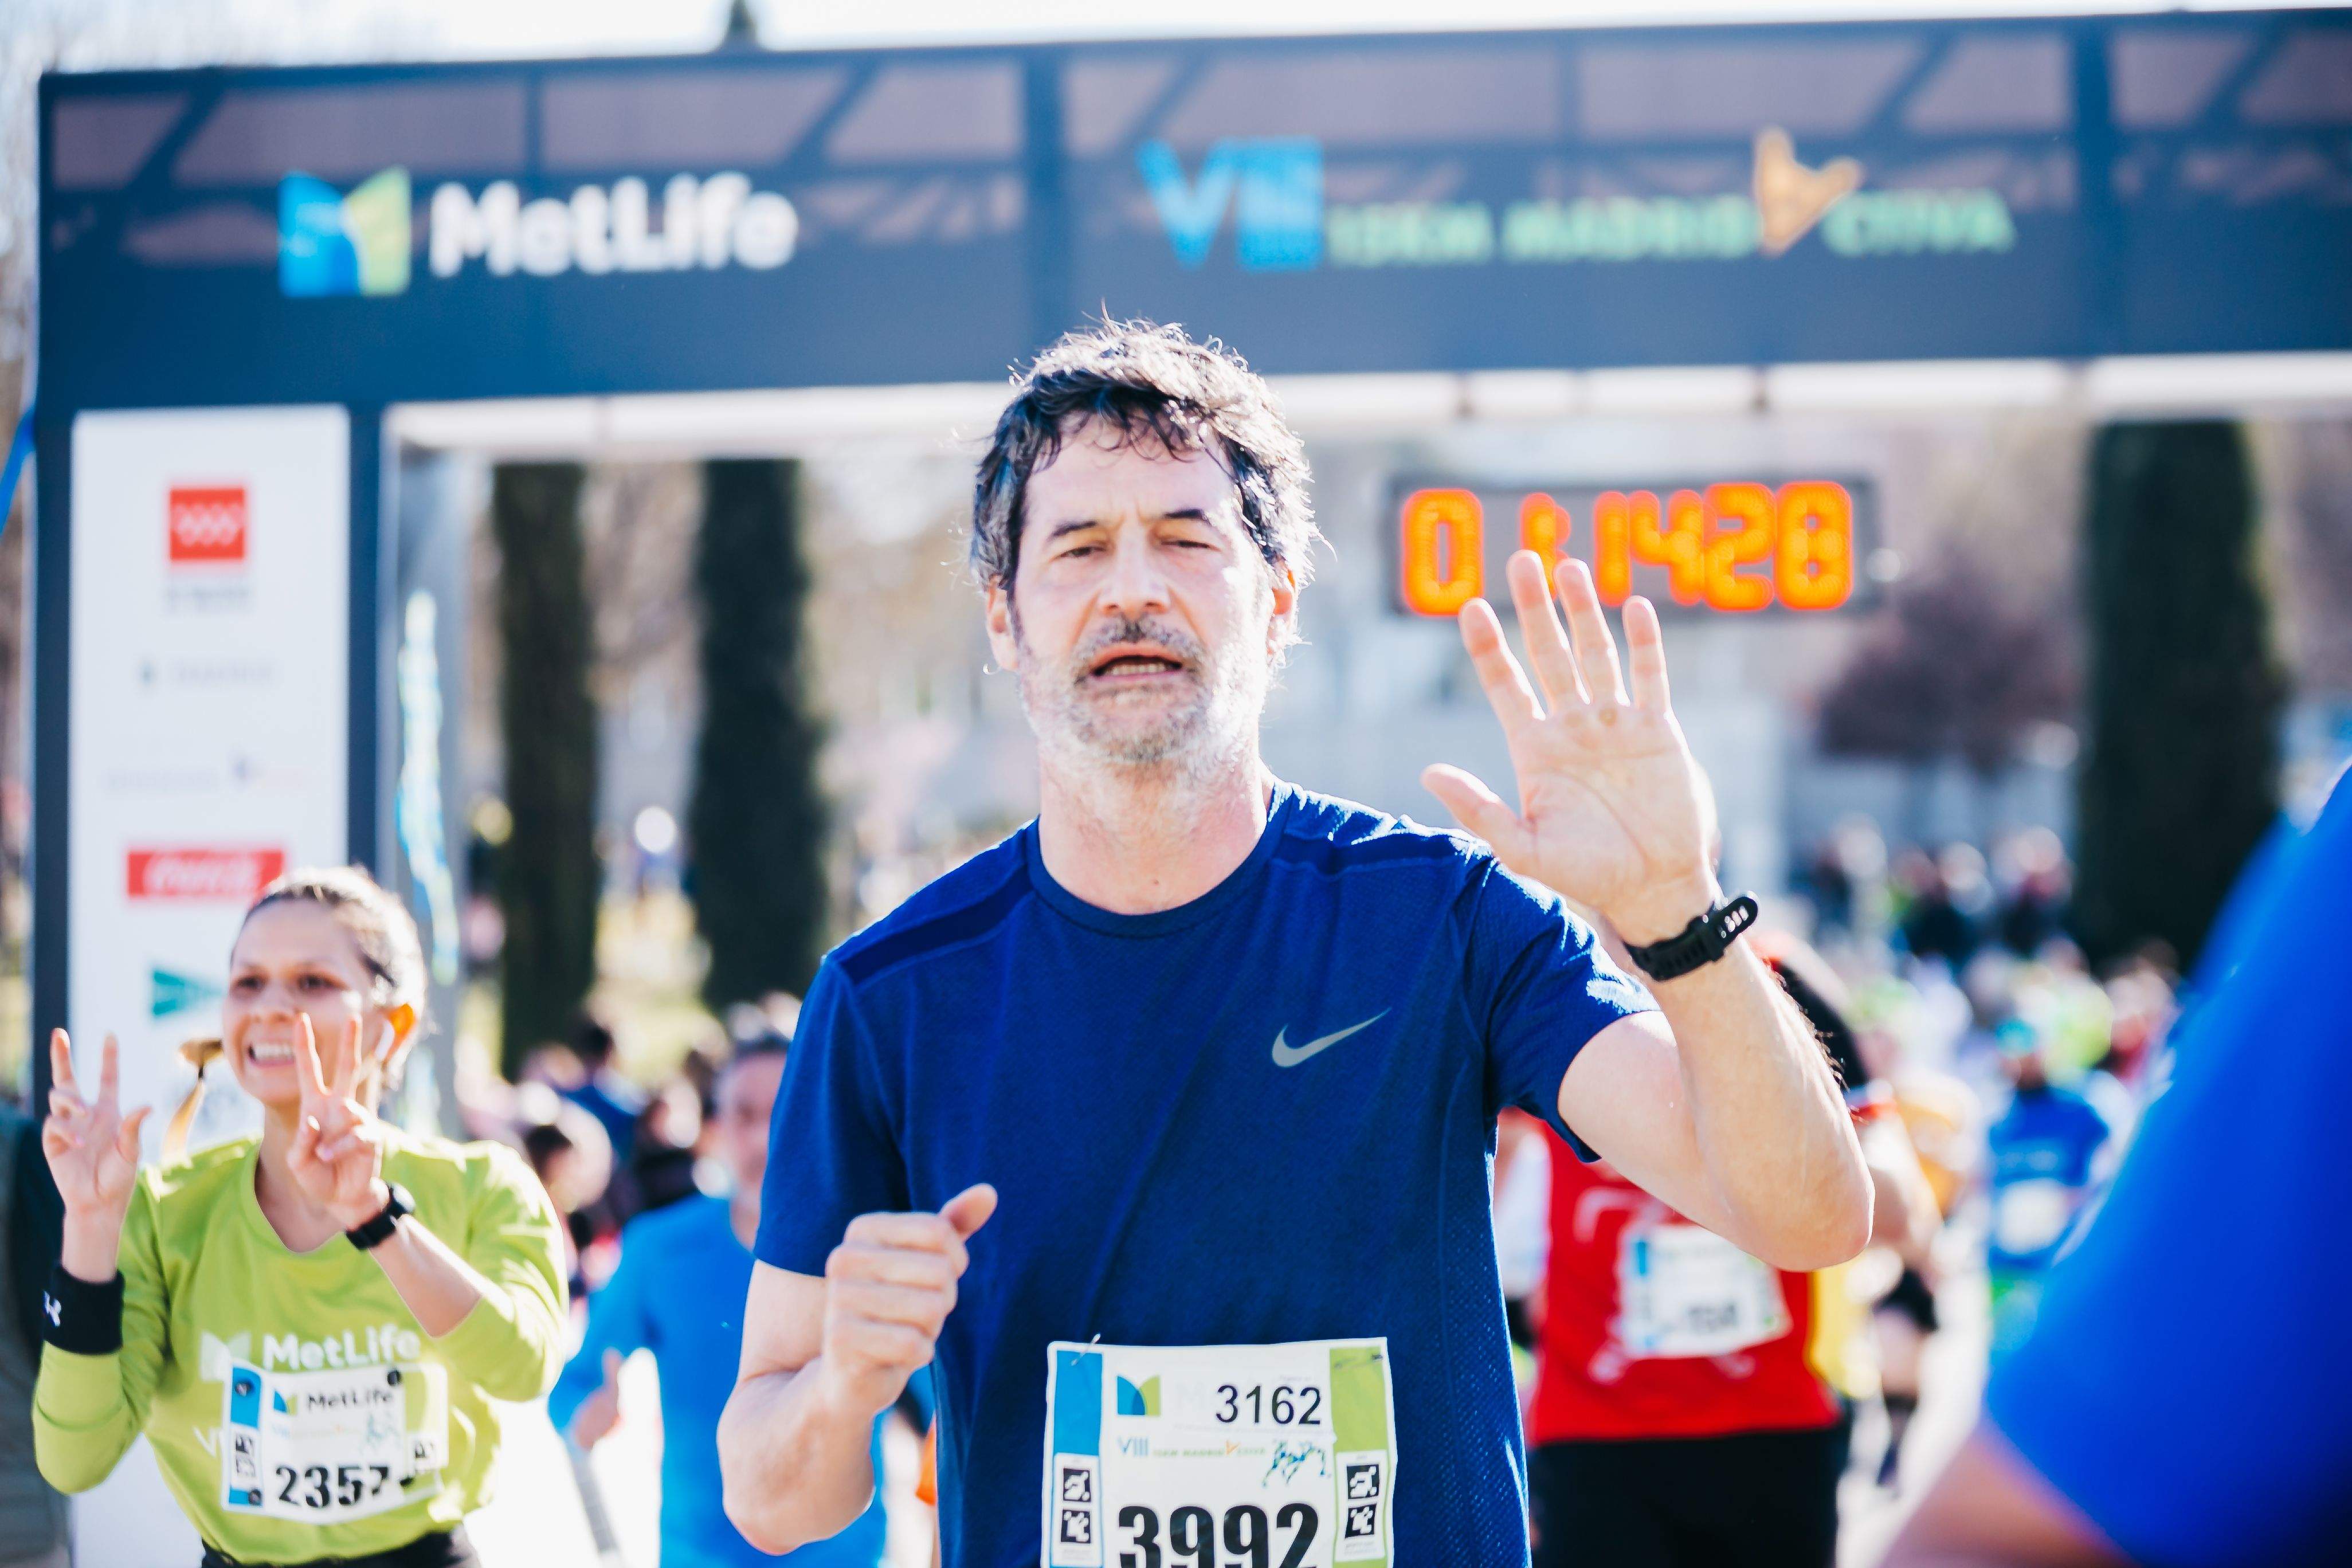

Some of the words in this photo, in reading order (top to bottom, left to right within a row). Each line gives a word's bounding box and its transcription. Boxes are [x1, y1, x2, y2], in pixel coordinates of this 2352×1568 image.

[430, 171, 798, 277] MetLife
[262, 1324, 421, 1371] MetLife
[308, 1389, 392, 1410] MetLife
[1216, 1384, 1322, 1425] 3162
[275, 1464, 390, 1508] 2357
[1118, 1502, 1320, 1568] 3992
